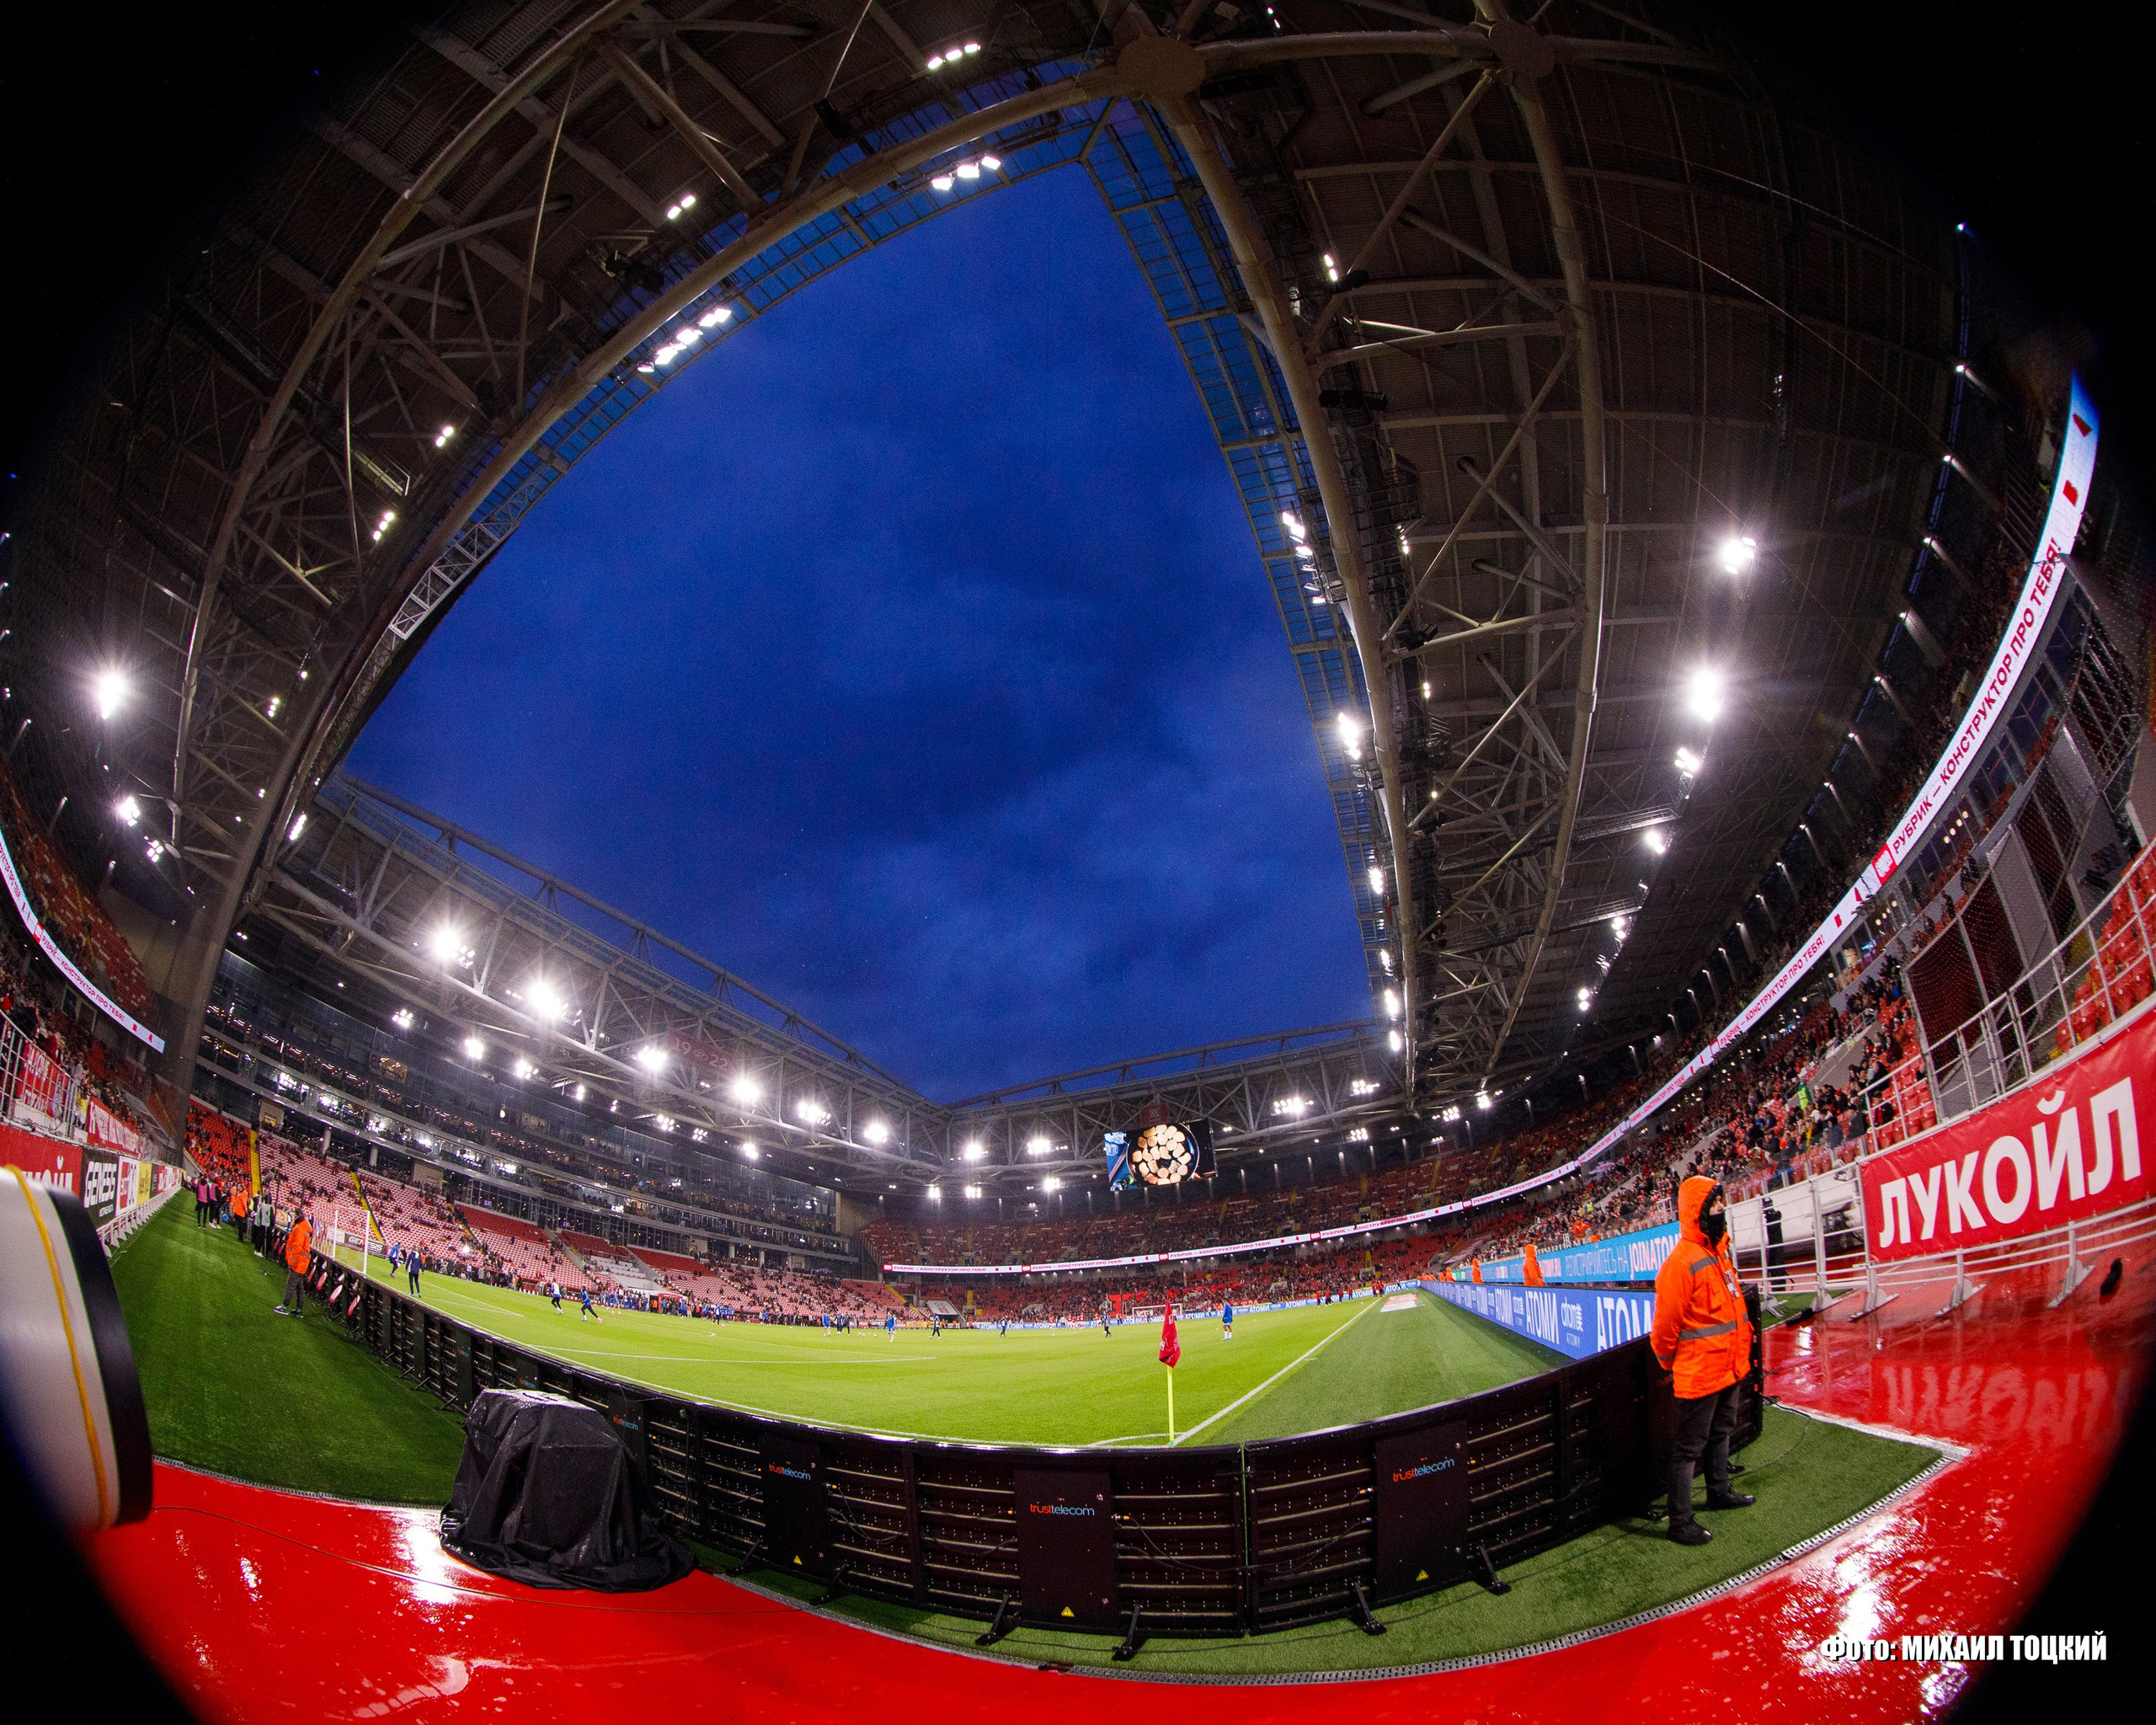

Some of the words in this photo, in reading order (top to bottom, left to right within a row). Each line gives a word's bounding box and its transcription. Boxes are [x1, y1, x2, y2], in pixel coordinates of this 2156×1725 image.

[1892, 795, 1933, 854] РУБРИК
[1940, 653, 2012, 785] КОНСТРУКТОР
[2009, 607, 2035, 657] ПРО
[2030, 537, 2062, 606] ТЕБЯ!
[42, 936, 57, 958] РУБРИК
[61, 960, 96, 996] КОНСТРУКТОР
[96, 994, 109, 1008] ПРО
[1720, 1023, 1741, 1046] РУБРИК
[1745, 974, 1789, 1023] КОНСТРУКТОР
[1787, 959, 1804, 979] ПРО
[1802, 934, 1826, 962] ТЕБЯ!
[709, 1054, 728, 1070] 22
[1879, 1076, 2142, 1248] ЛУКОЙЛ
[1198, 1245, 1241, 1254] КОНСТРУКТОР
[1352, 1289, 1374, 1299] АТОМИ
[1249, 1305, 1270, 1314] АТОМИ
[1285, 1300, 1306, 1309] АТОМИ
[1186, 1311, 1205, 1321] АТОМИ
[1525, 1290, 1560, 1345] АТОМИ
[1597, 1296, 1652, 1352] АТОМ
[769, 1463, 811, 1481] trusttelecom
[1393, 1458, 1455, 1482] trusttelecom
[1030, 1503, 1095, 1516] trusttelecom
